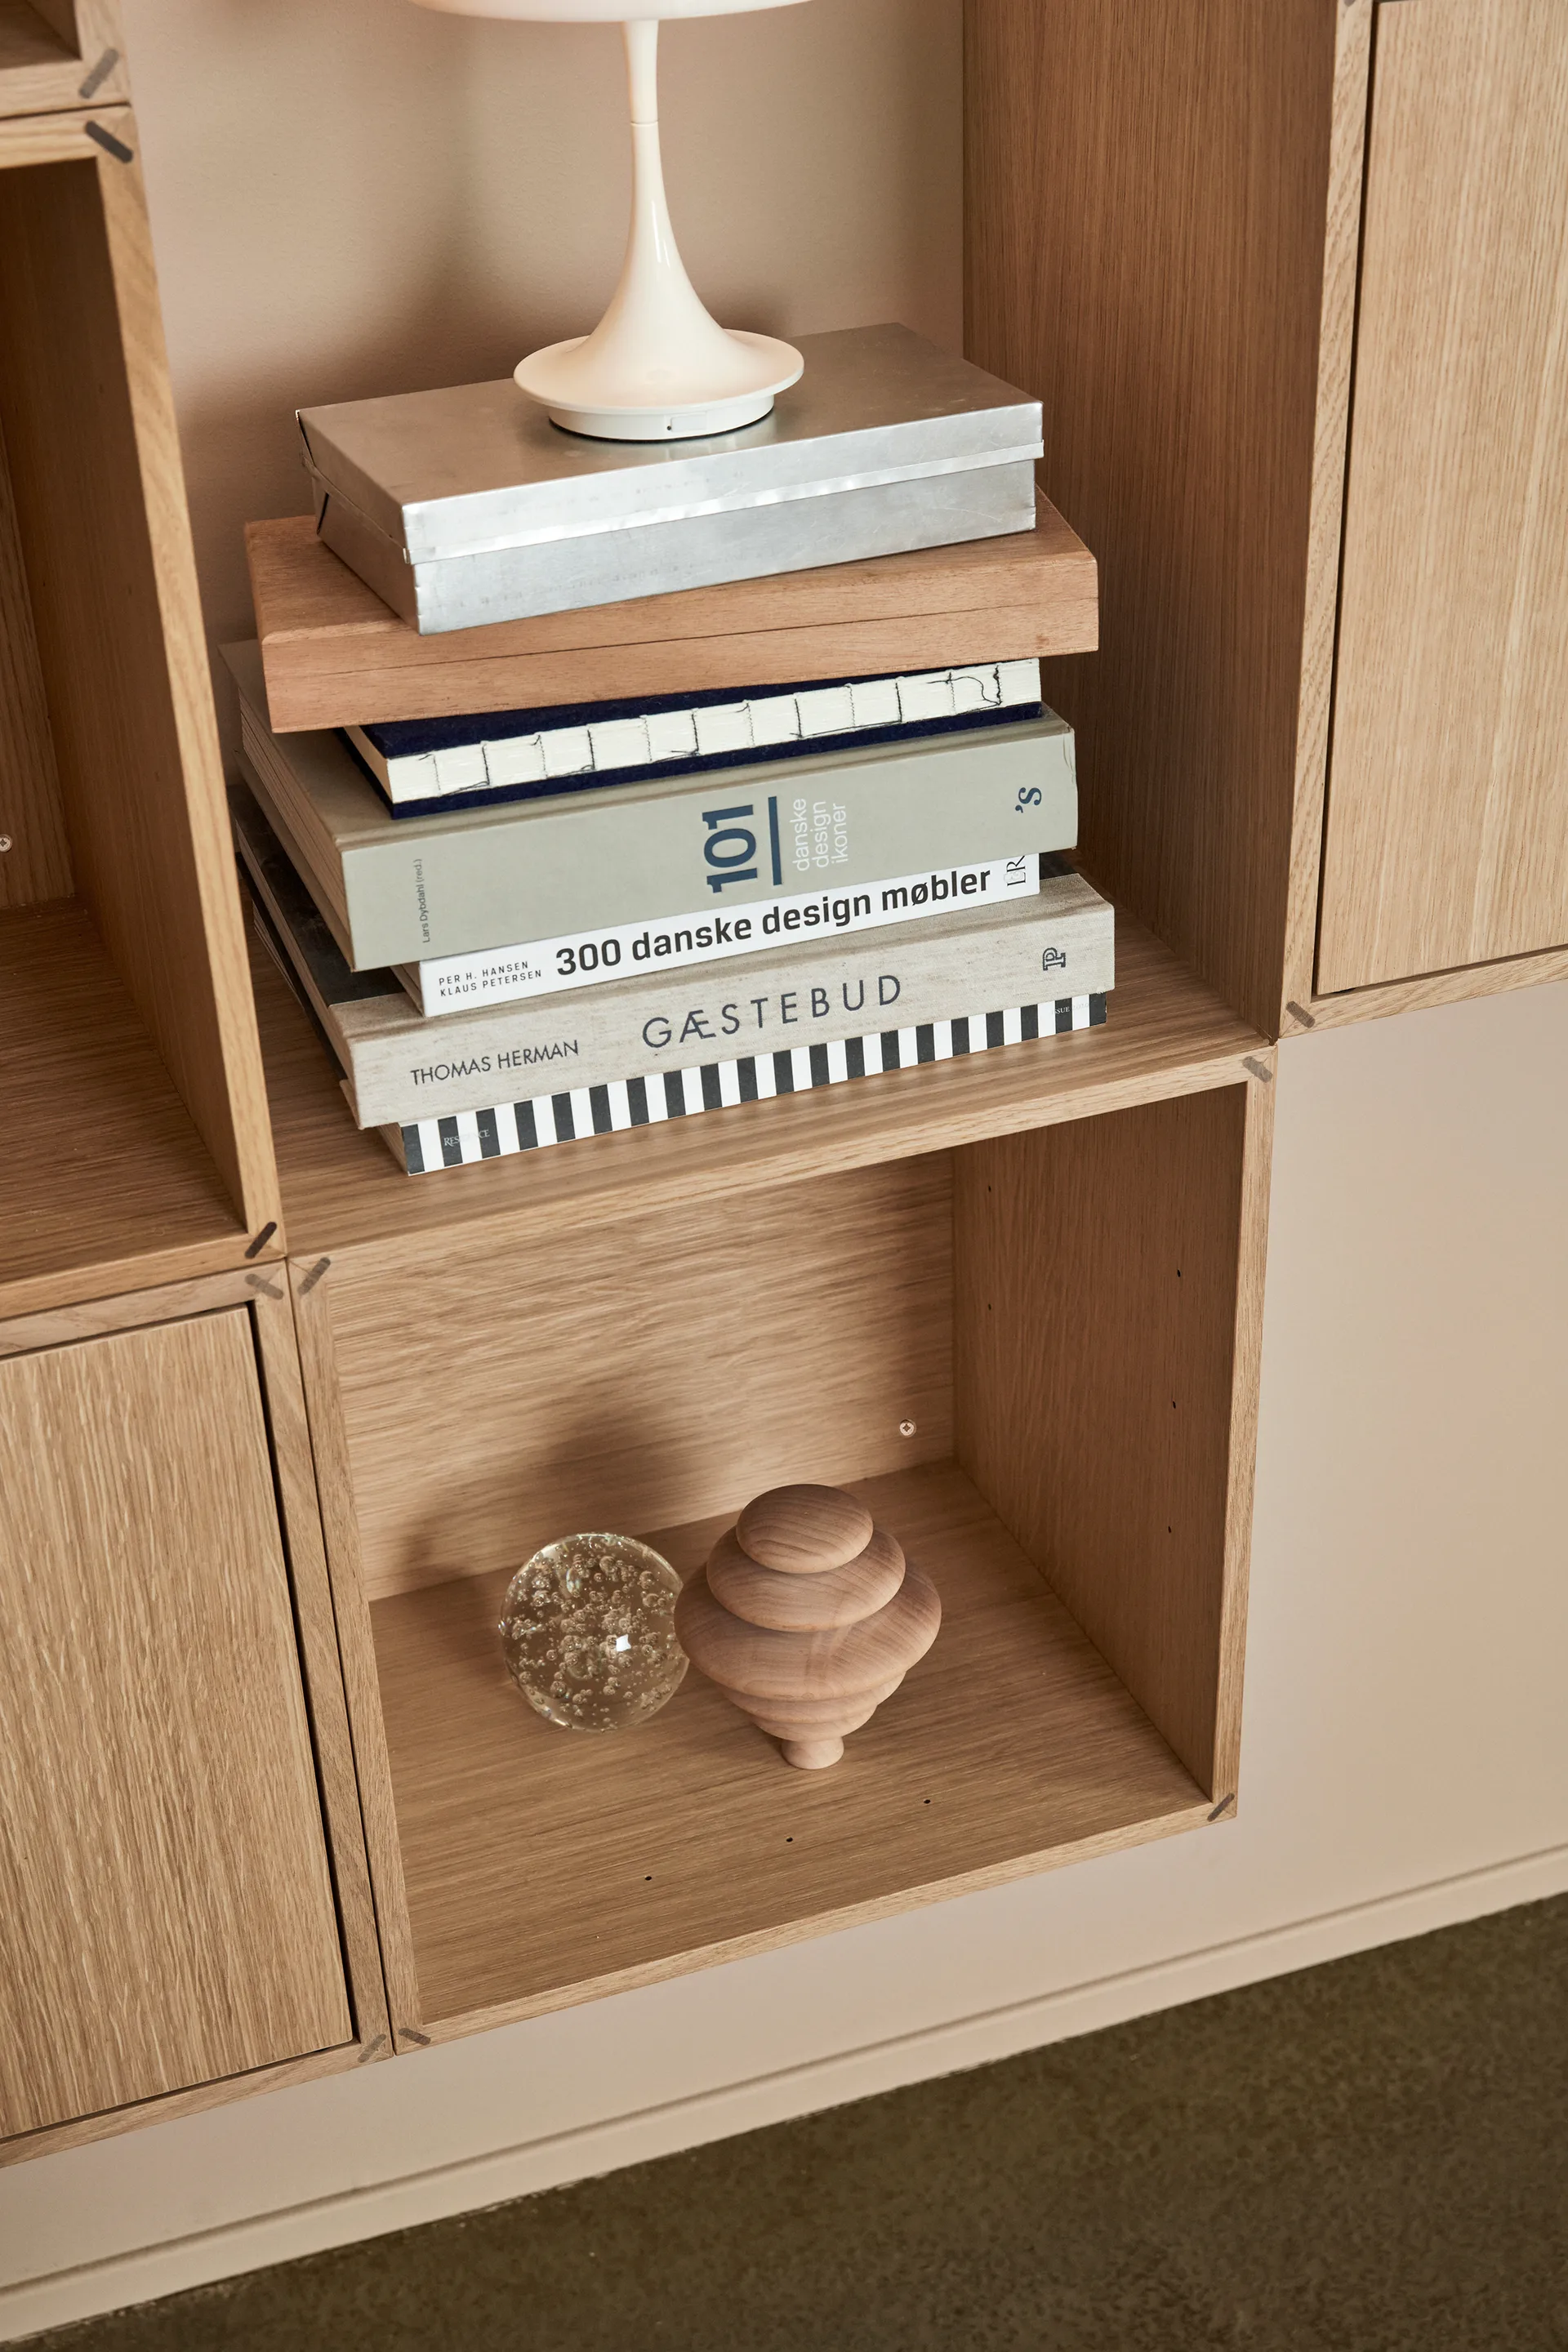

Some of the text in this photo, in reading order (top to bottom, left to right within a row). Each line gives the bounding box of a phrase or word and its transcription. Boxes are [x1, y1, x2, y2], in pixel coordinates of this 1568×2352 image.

[702, 804, 758, 893] 101
[789, 799, 810, 871] danske
[810, 801, 831, 868] design
[831, 803, 849, 864] ikoner
[412, 858, 430, 943] Lars Dybdahl (red.)
[555, 869, 991, 976] 300 danske design møbler
[439, 960, 529, 986] PER H. HANSEN
[440, 969, 542, 997] KLAUS PETERSEN
[641, 974, 902, 1049] GÆSTEBUD
[410, 1040, 580, 1087] THOMAS HERMAN
